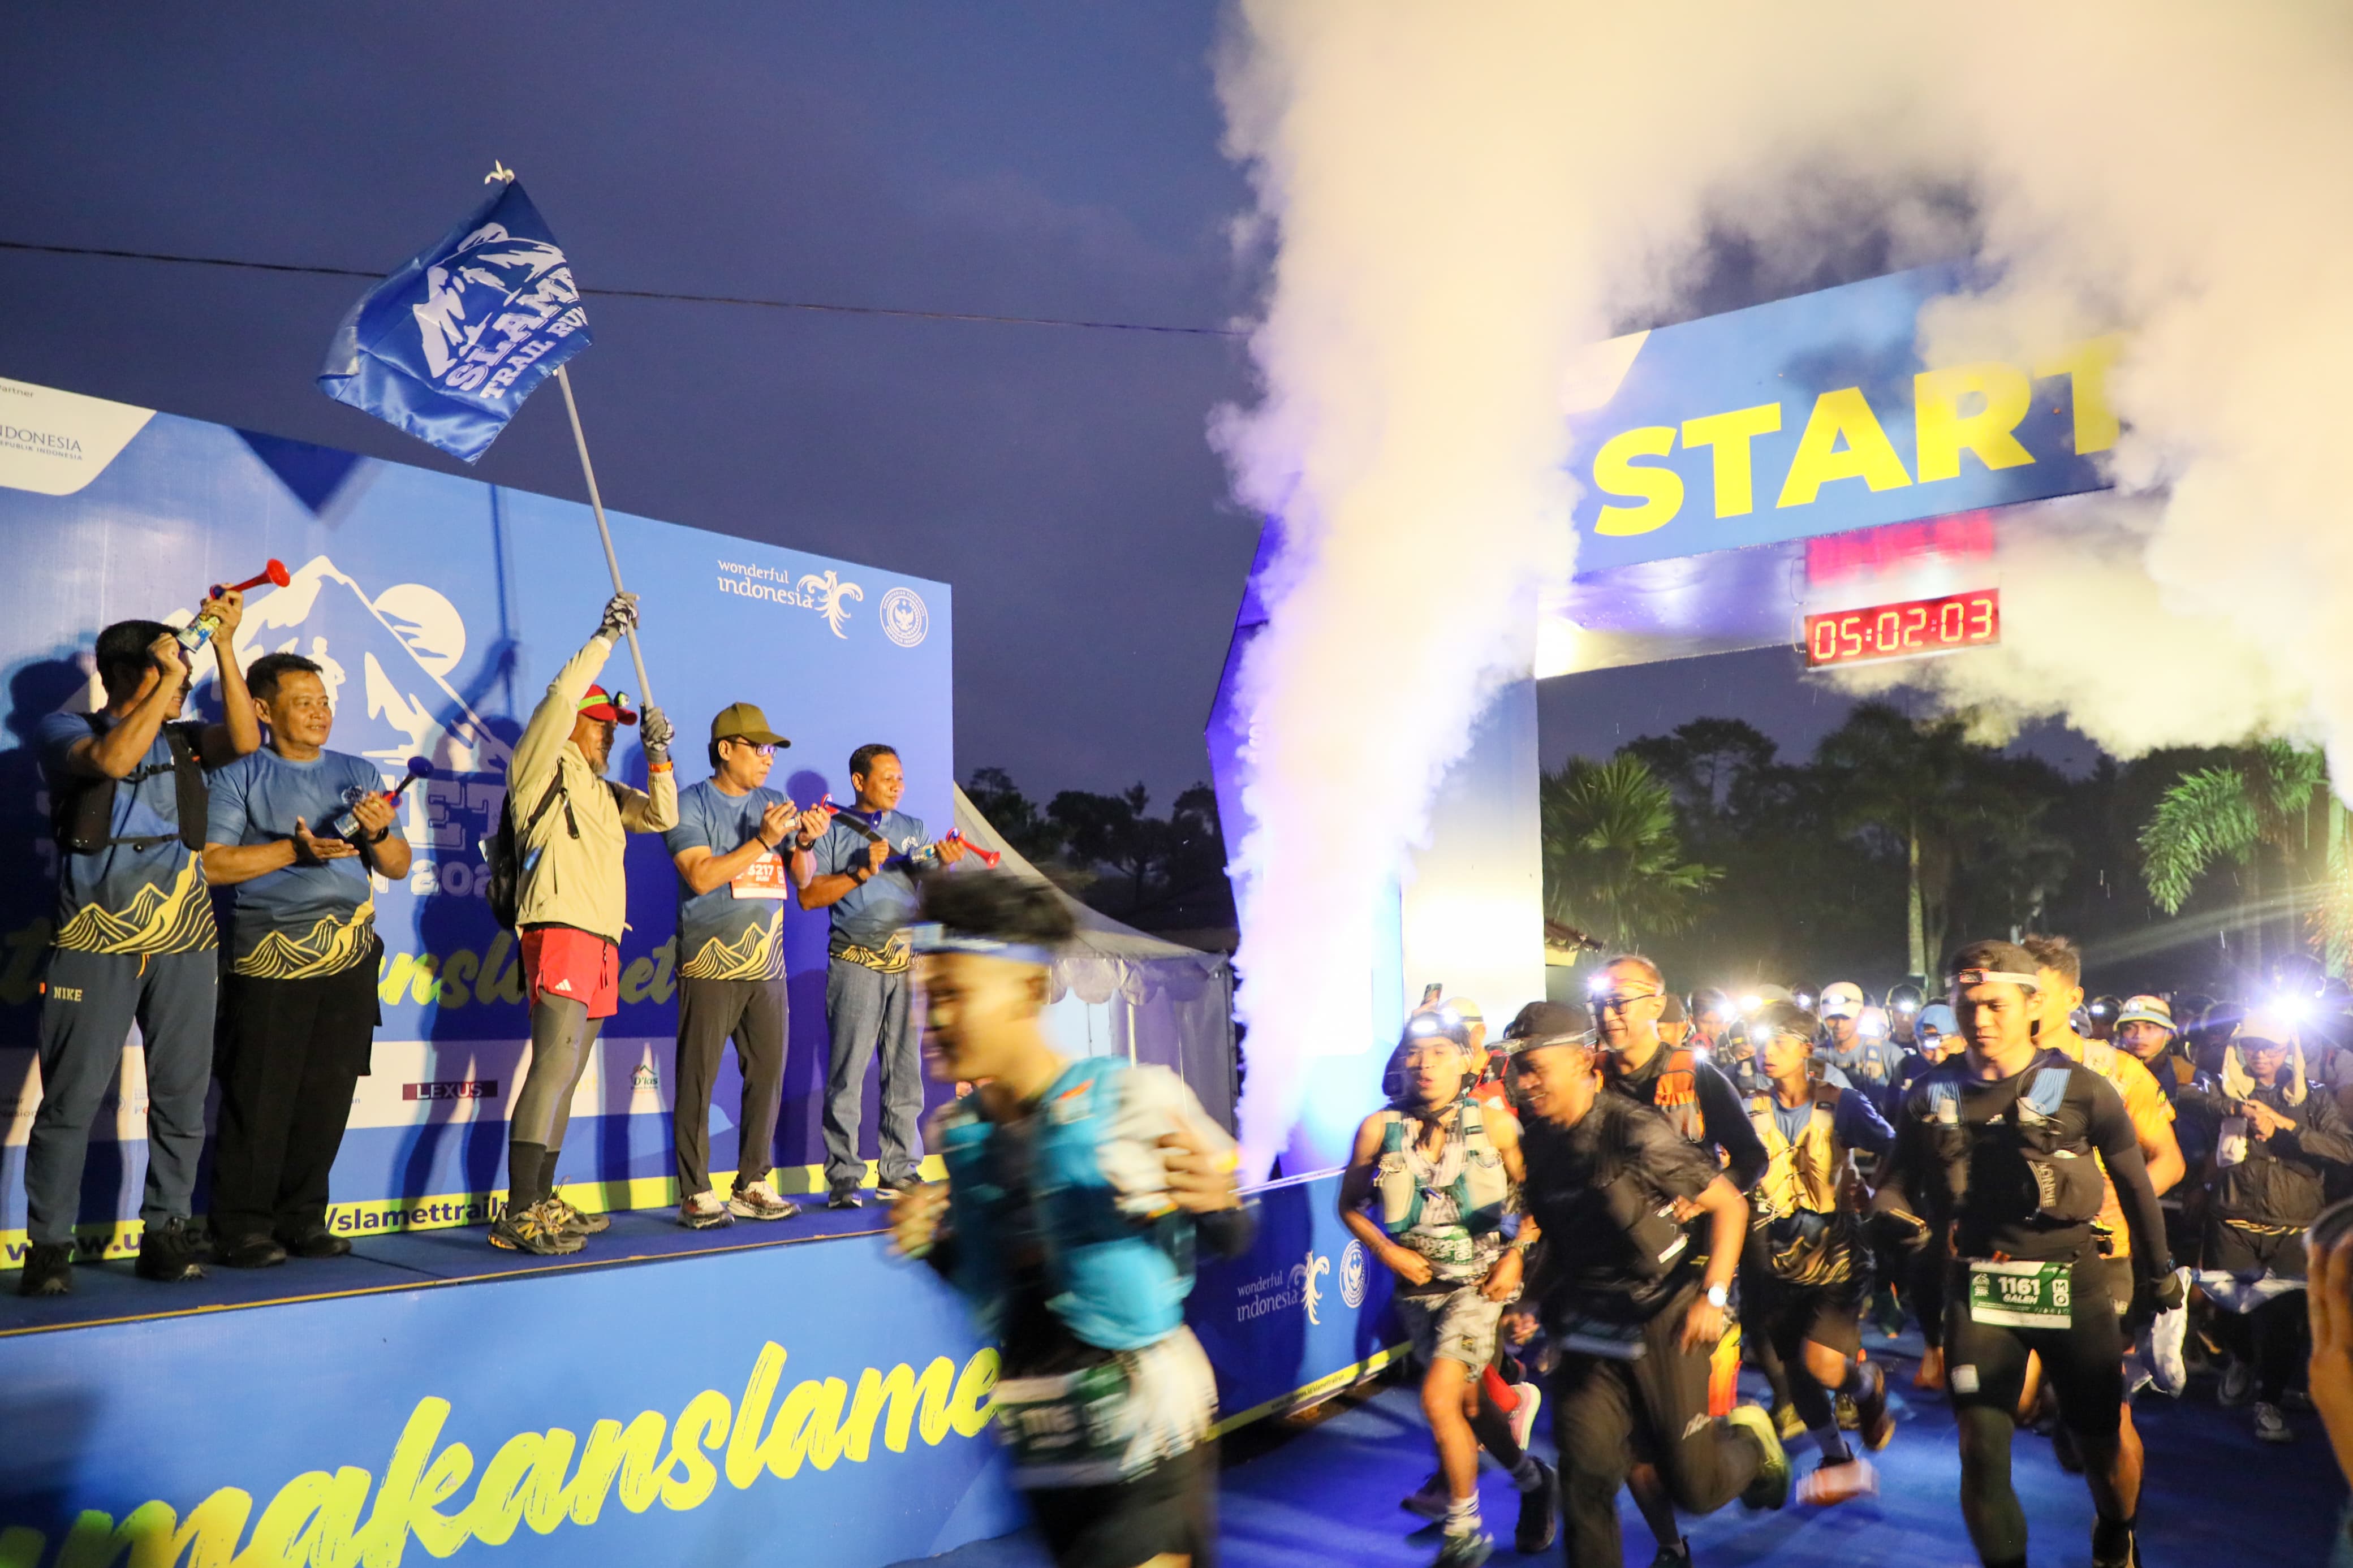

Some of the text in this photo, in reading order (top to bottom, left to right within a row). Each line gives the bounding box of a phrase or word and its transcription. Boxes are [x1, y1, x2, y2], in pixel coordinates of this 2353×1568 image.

[480, 339, 556, 399] TRAIL
[0, 385, 33, 398] artner
[1593, 334, 2122, 536] START
[37, 447, 83, 460] INDONESIA
[717, 559, 790, 584] wonderful
[717, 576, 815, 609] indonesia
[1814, 599, 1993, 660] 05:02:03
[54, 986, 83, 1001] NIKE
[416, 1082, 482, 1099] LEXUS
[1237, 1269, 1283, 1298] wonderful
[1998, 1276, 2041, 1295] 1161
[1236, 1286, 1300, 1323] indonesia
